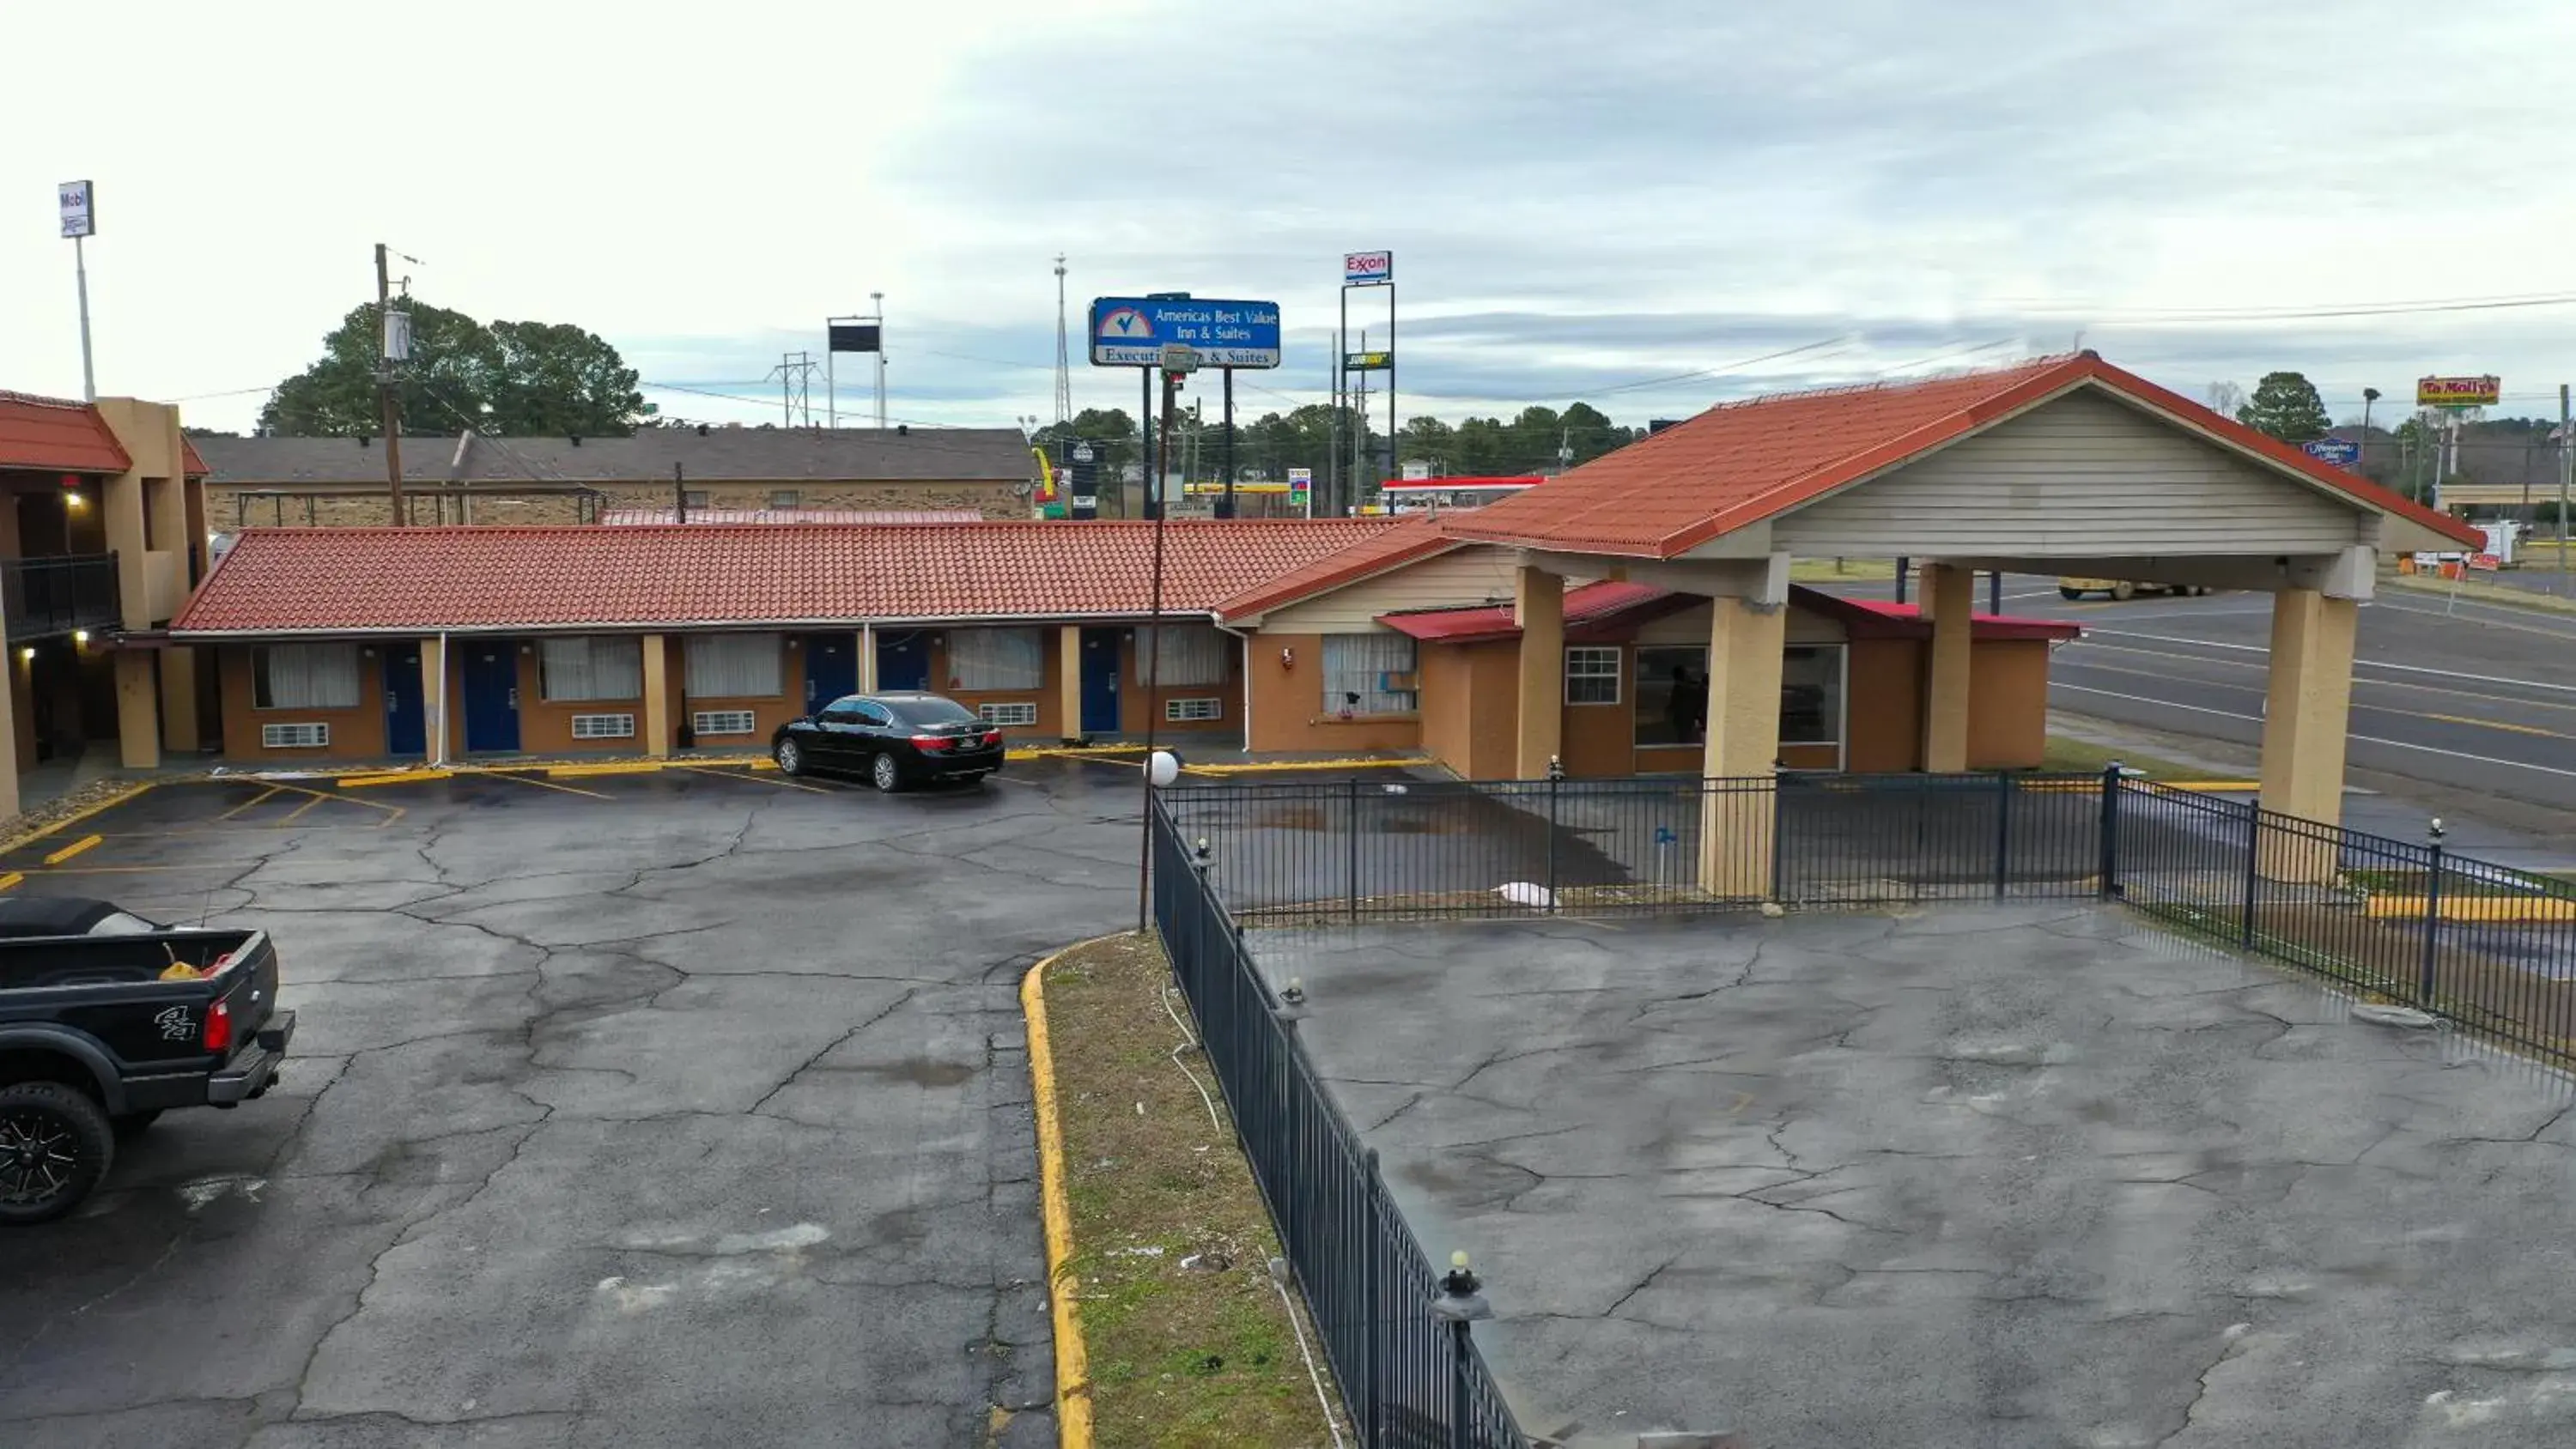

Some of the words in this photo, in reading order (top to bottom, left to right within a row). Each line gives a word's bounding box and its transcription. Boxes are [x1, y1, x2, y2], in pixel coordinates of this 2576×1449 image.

[1347, 257, 1386, 272] Exxon
[1155, 309, 1211, 323] Americas
[1215, 310, 1241, 323] Best
[1245, 311, 1278, 324] Value
[1177, 326, 1196, 339] Inn
[1200, 326, 1210, 339] &
[1216, 326, 1251, 340] Suites
[1105, 348, 1161, 362] Executi
[1210, 351, 1220, 361] &
[1227, 348, 1270, 362] Suites
